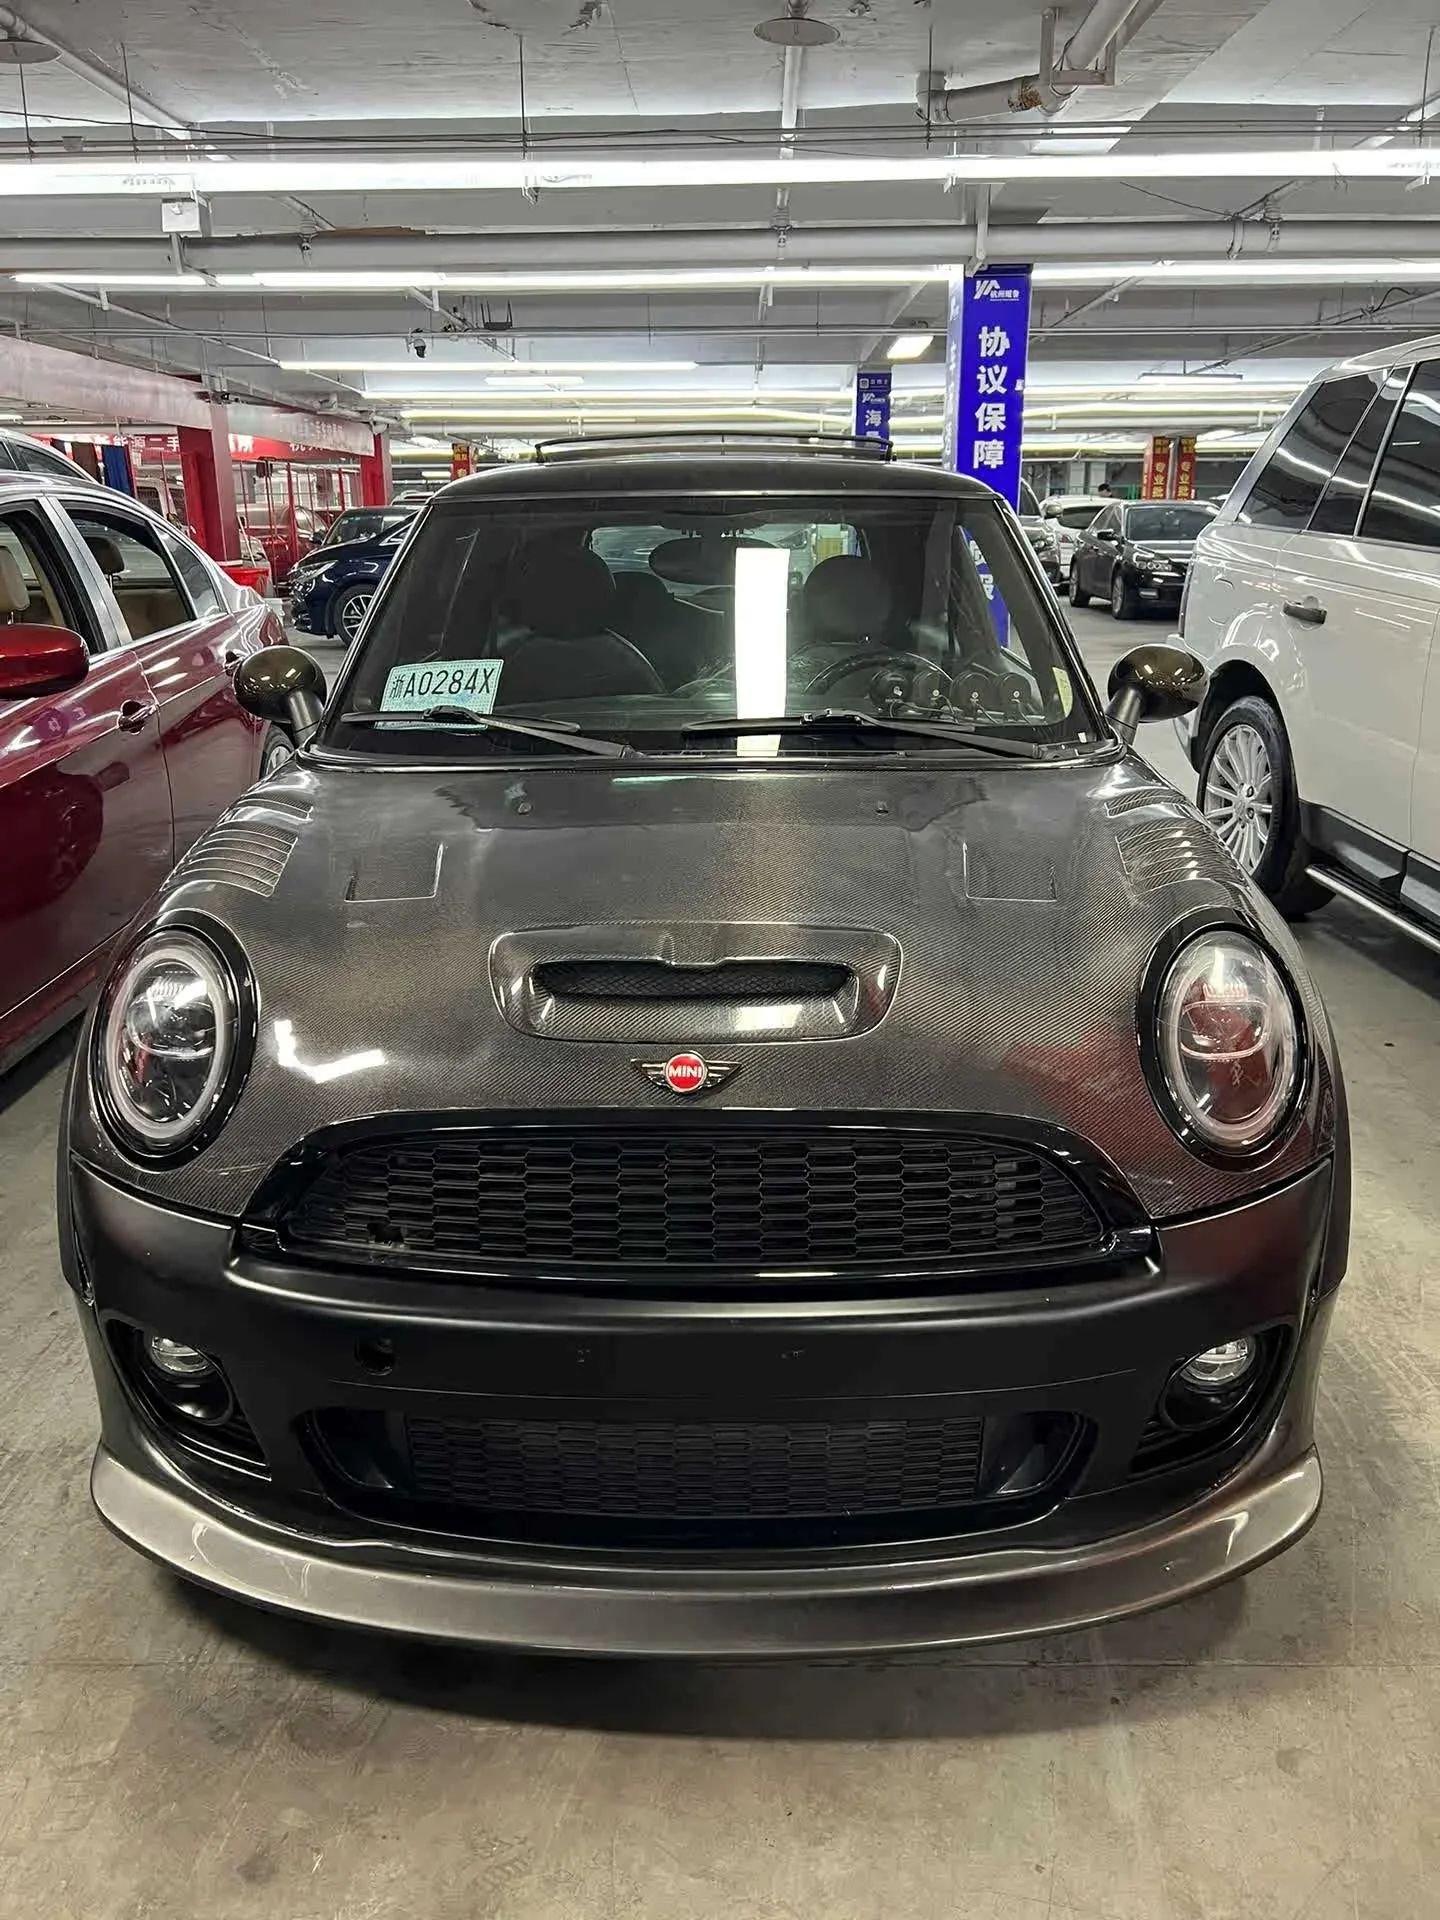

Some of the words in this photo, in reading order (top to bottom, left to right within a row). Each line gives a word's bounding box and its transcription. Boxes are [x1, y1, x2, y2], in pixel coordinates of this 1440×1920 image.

[973, 326, 1011, 469] 协议保障
[668, 1064, 703, 1078] MINI
